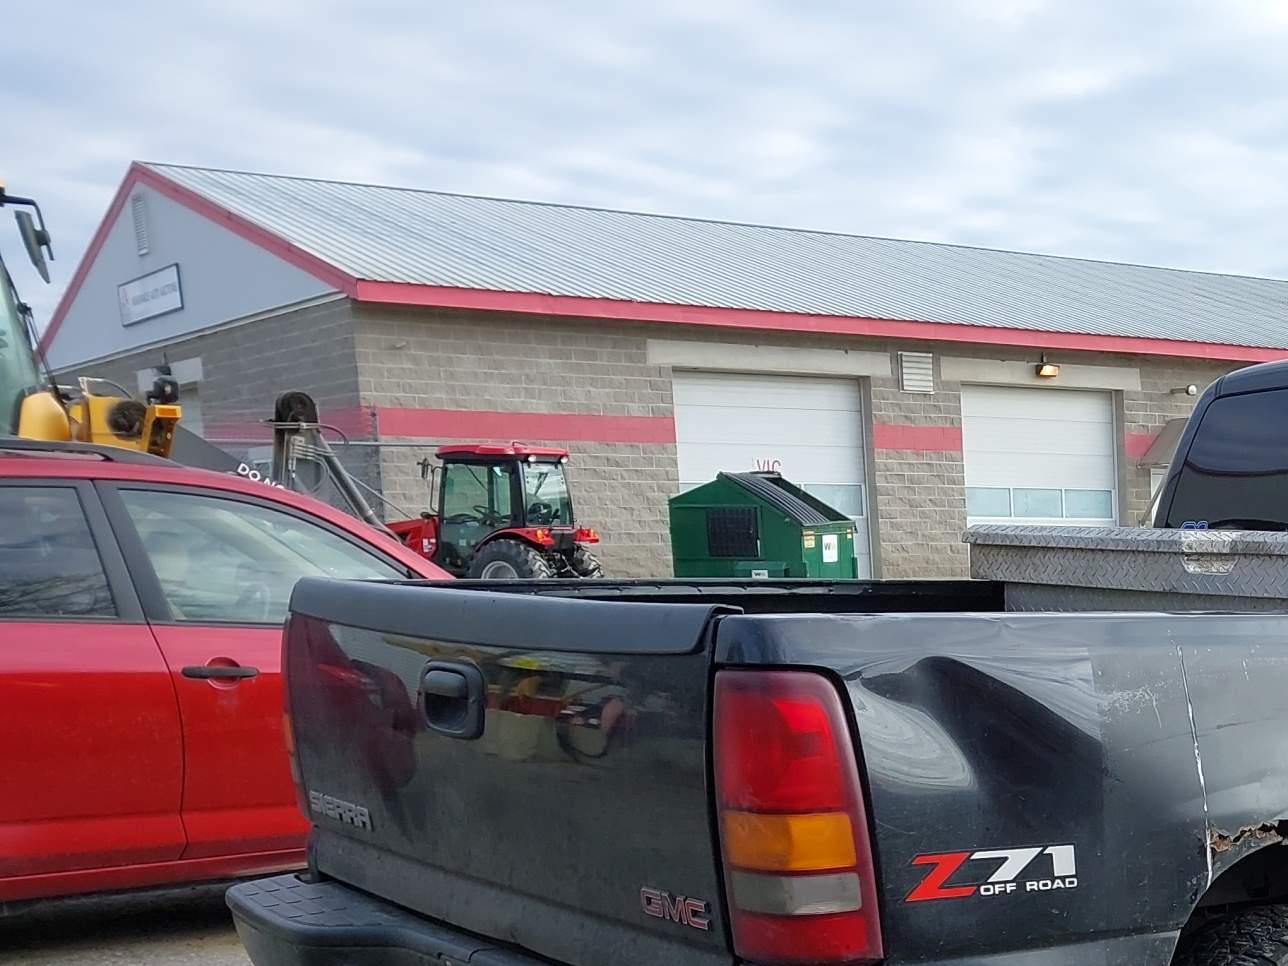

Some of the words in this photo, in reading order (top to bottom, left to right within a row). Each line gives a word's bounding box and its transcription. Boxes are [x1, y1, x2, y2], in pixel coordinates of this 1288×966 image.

[237, 462, 261, 481] DO
[309, 789, 371, 831] SIERRA
[905, 844, 1077, 902] Z71
[979, 882, 1017, 896] OFF
[1025, 877, 1078, 892] ROAD
[640, 886, 710, 931] GMC
